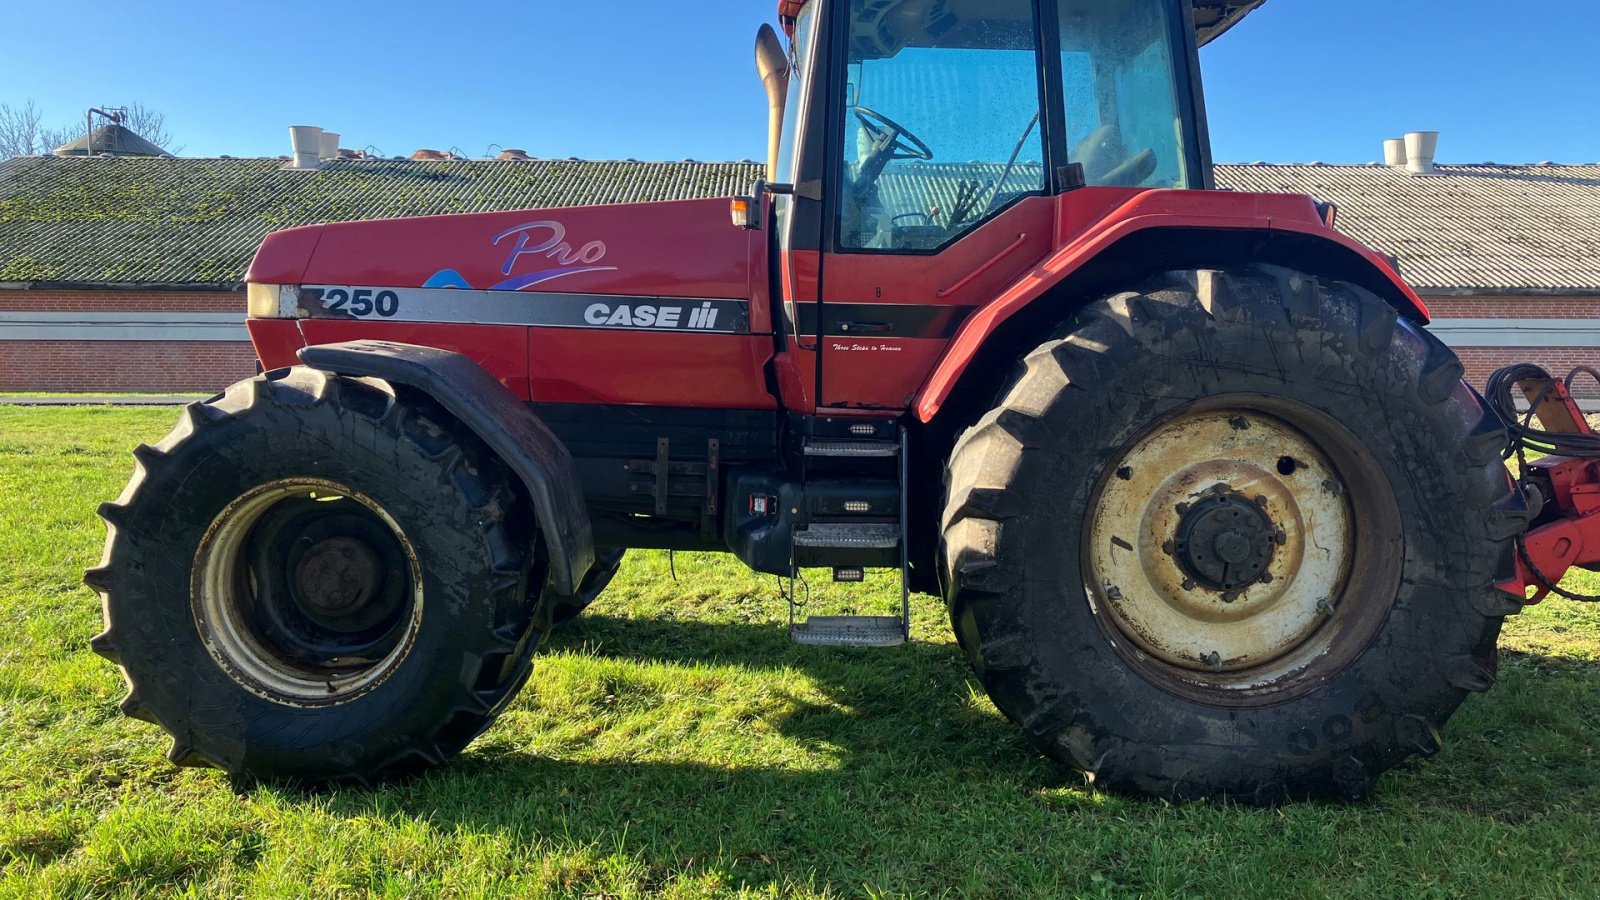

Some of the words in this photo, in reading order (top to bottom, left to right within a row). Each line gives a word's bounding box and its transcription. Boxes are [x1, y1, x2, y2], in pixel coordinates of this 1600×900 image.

[491, 220, 606, 276] Pro
[583, 303, 683, 327] CASE
[832, 343, 849, 351] Three
[851, 343, 869, 351] Steps
